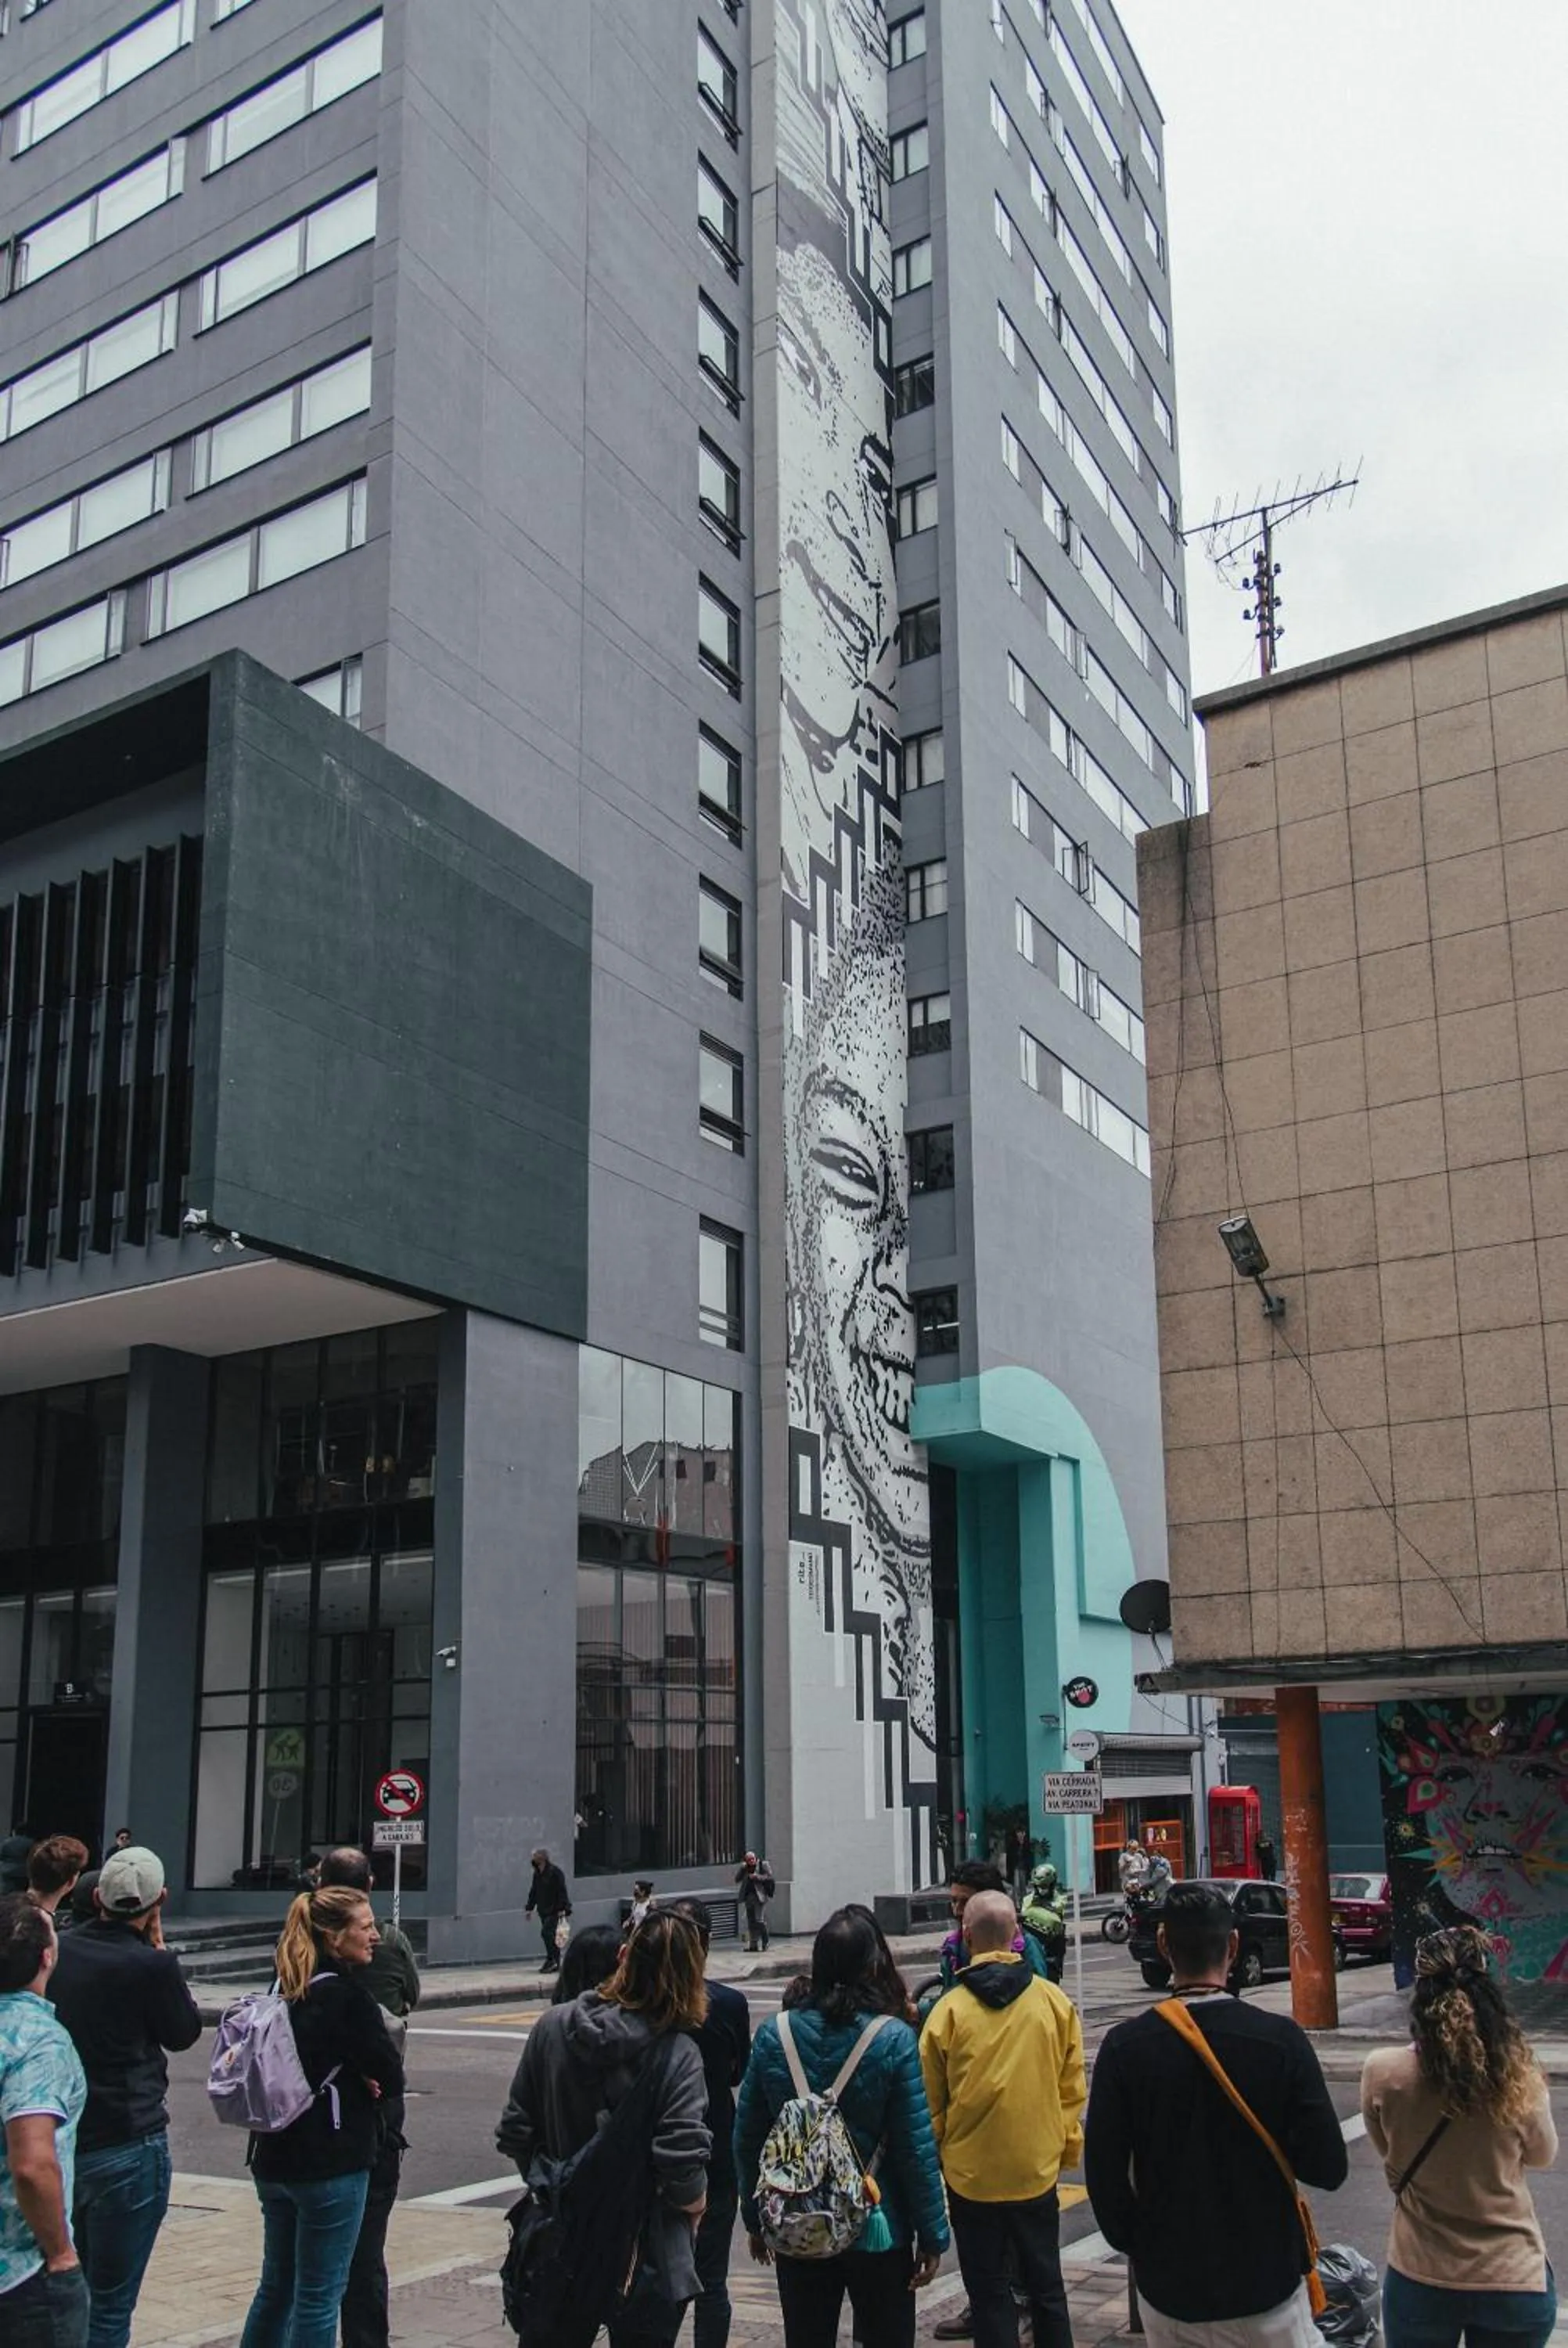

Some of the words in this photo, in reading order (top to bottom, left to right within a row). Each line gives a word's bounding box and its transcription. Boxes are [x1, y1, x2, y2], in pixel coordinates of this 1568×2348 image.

[1048, 1777, 1059, 1786] VIA
[1062, 1777, 1096, 1786] CERRADA
[1059, 1788, 1091, 1798] CARRERA
[1048, 1800, 1059, 1809] VIA
[1062, 1799, 1097, 1809] PEATONAL
